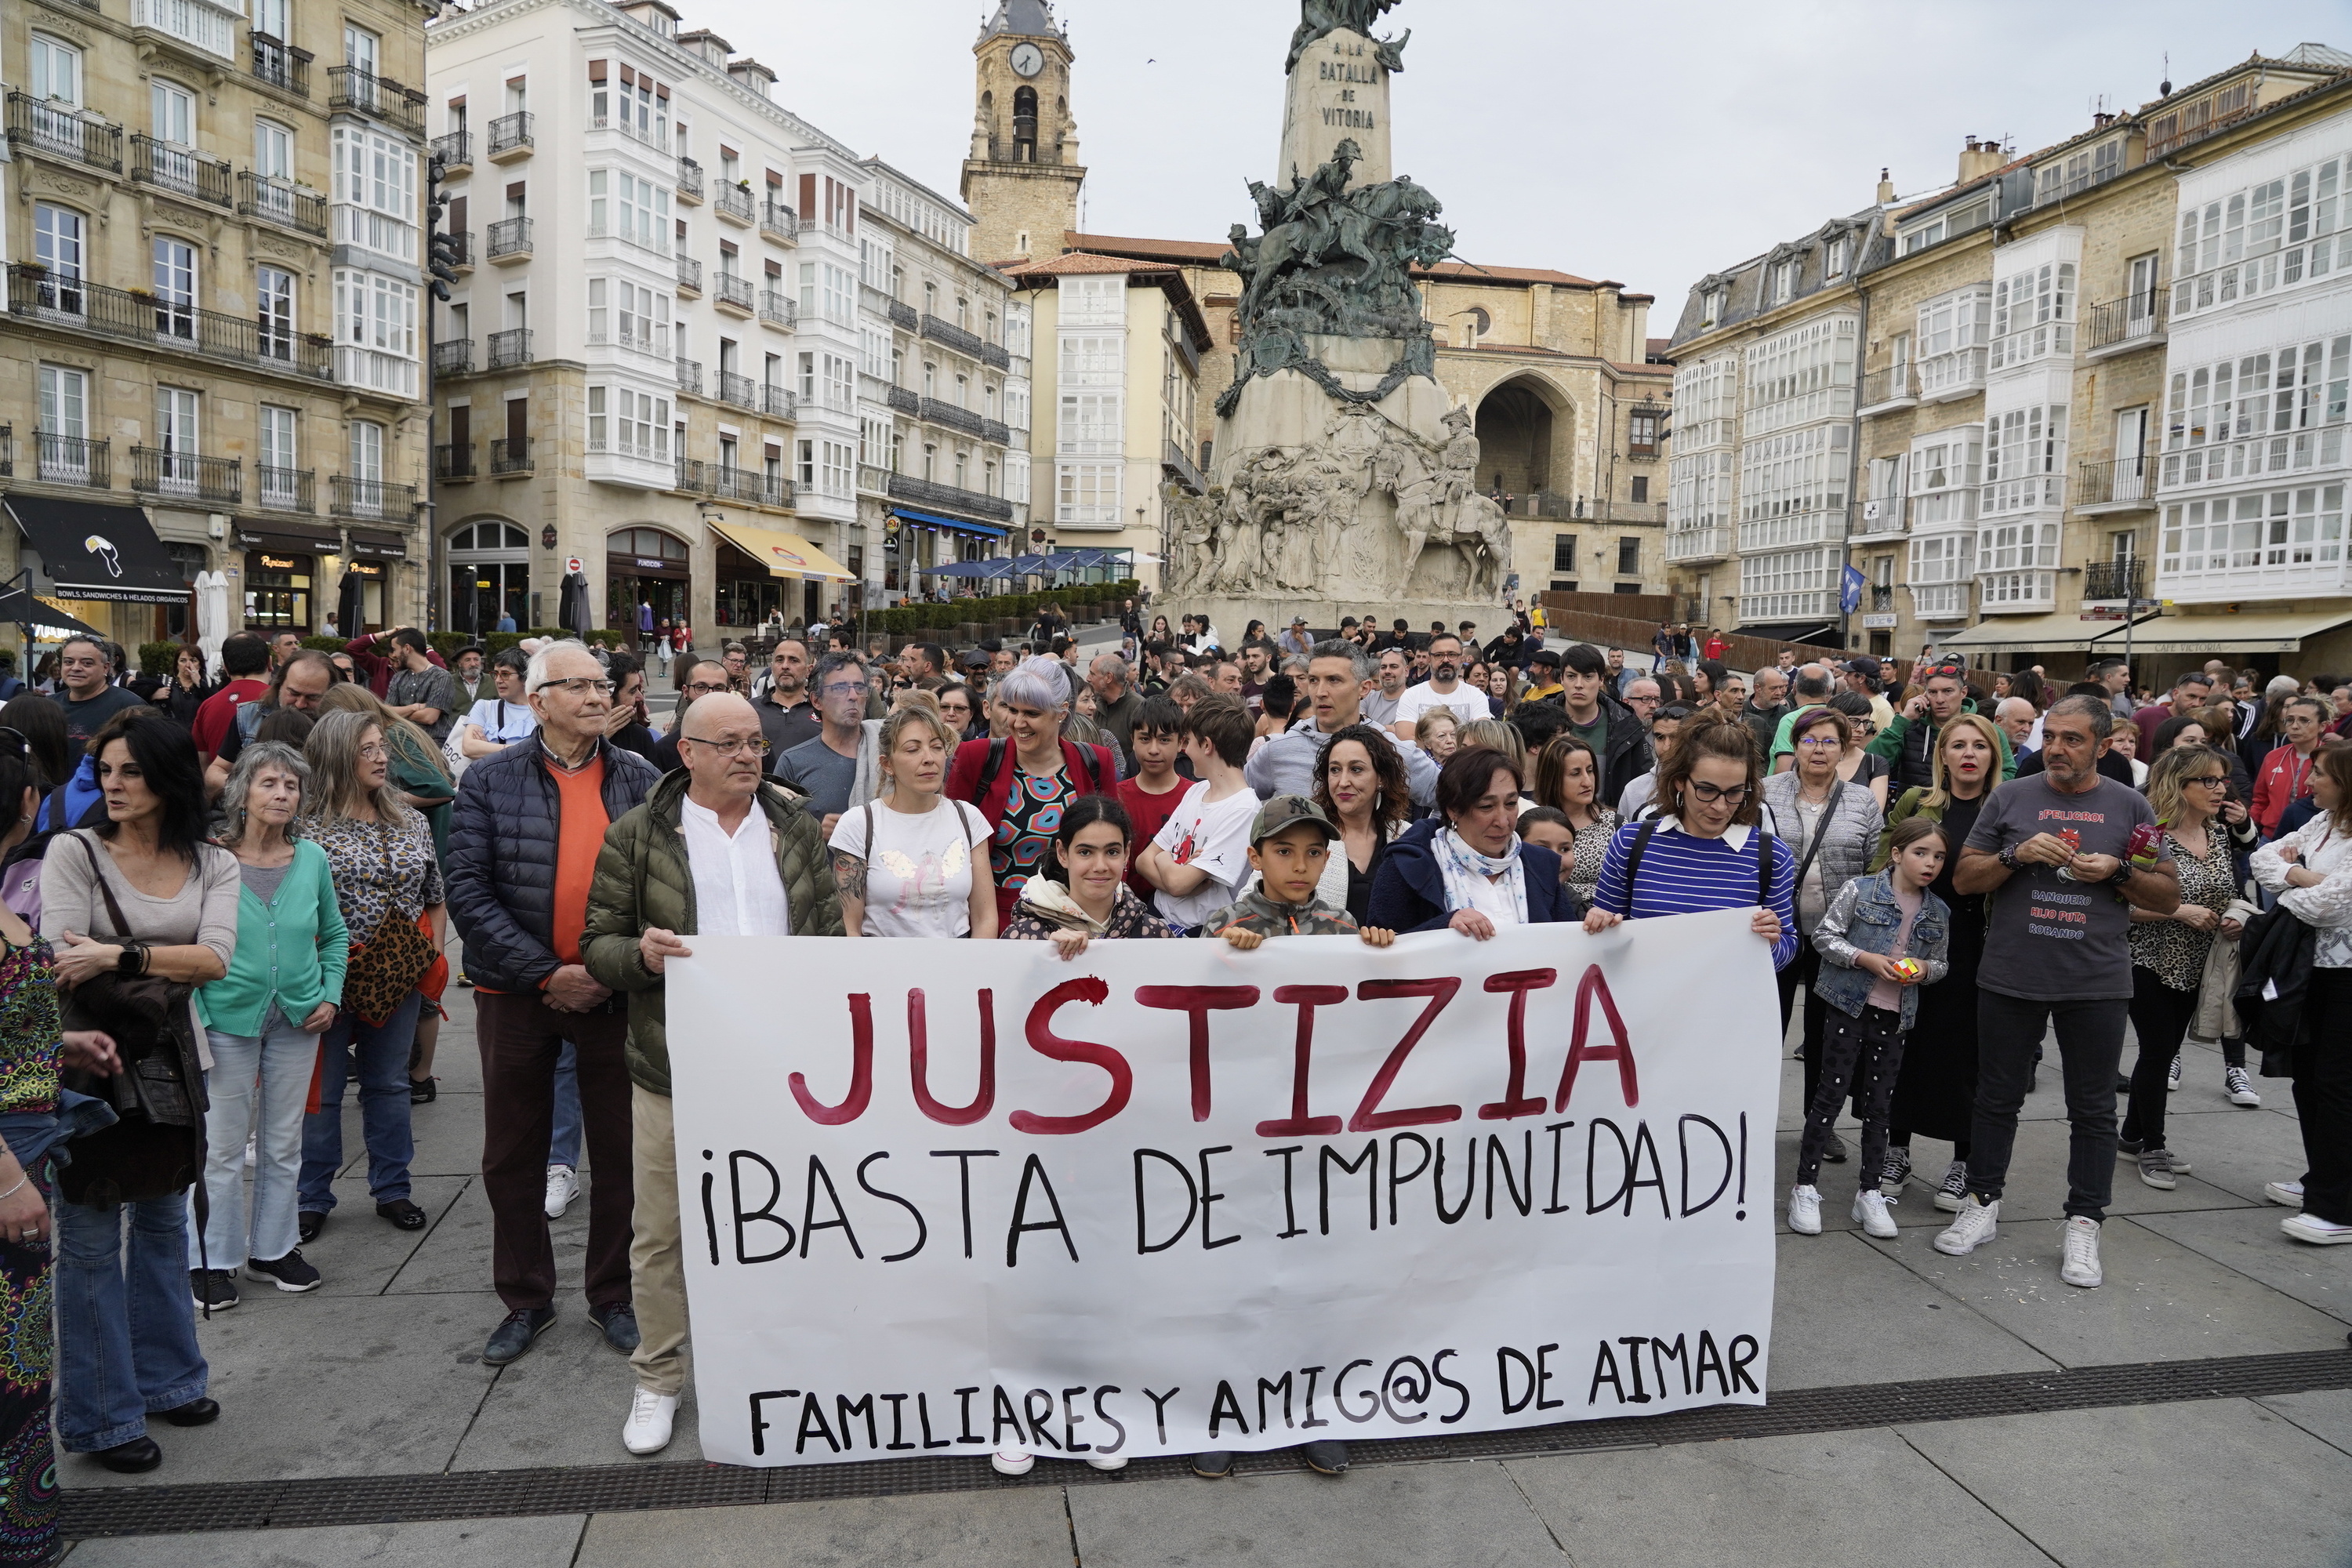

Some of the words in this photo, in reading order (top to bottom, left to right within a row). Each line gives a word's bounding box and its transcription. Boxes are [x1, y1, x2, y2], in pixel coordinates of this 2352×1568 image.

[1334, 42, 1341, 55] A
[1348, 43, 1363, 56] LA
[1319, 60, 1378, 85] BATALLA
[1341, 89, 1356, 102] DE
[1322, 107, 1374, 129] VITORIA
[57, 590, 82, 598] BOWLS,
[82, 591, 122, 601] SANDWICHES
[157, 595, 189, 604] ORGÁNICOS
[2003, 644, 2034, 652] VICTORIA
[2180, 642, 2222, 652] VICTORIA
[2038, 809, 2104, 823] ¡PELIGRO!
[2031, 890, 2092, 906] BANQUERO
[2030, 907, 2056, 920] HIJO
[2058, 911, 2087, 924] PUTA
[2028, 924, 2085, 940] ROBANDO
[788, 964, 1639, 1138] JUSTIZIA
[702, 1149, 1080, 1268] ¡BASTA
[1134, 1145, 1242, 1255] DE
[1263, 1110, 1747, 1239] IMPUNIDAD!
[749, 1385, 1127, 1456] FAMILIARES
[1142, 1385, 1181, 1446] Y
[1207, 1348, 1470, 1438] AMIG@S
[1497, 1343, 1563, 1414] DE
[1588, 1329, 1760, 1405] AIMAR
